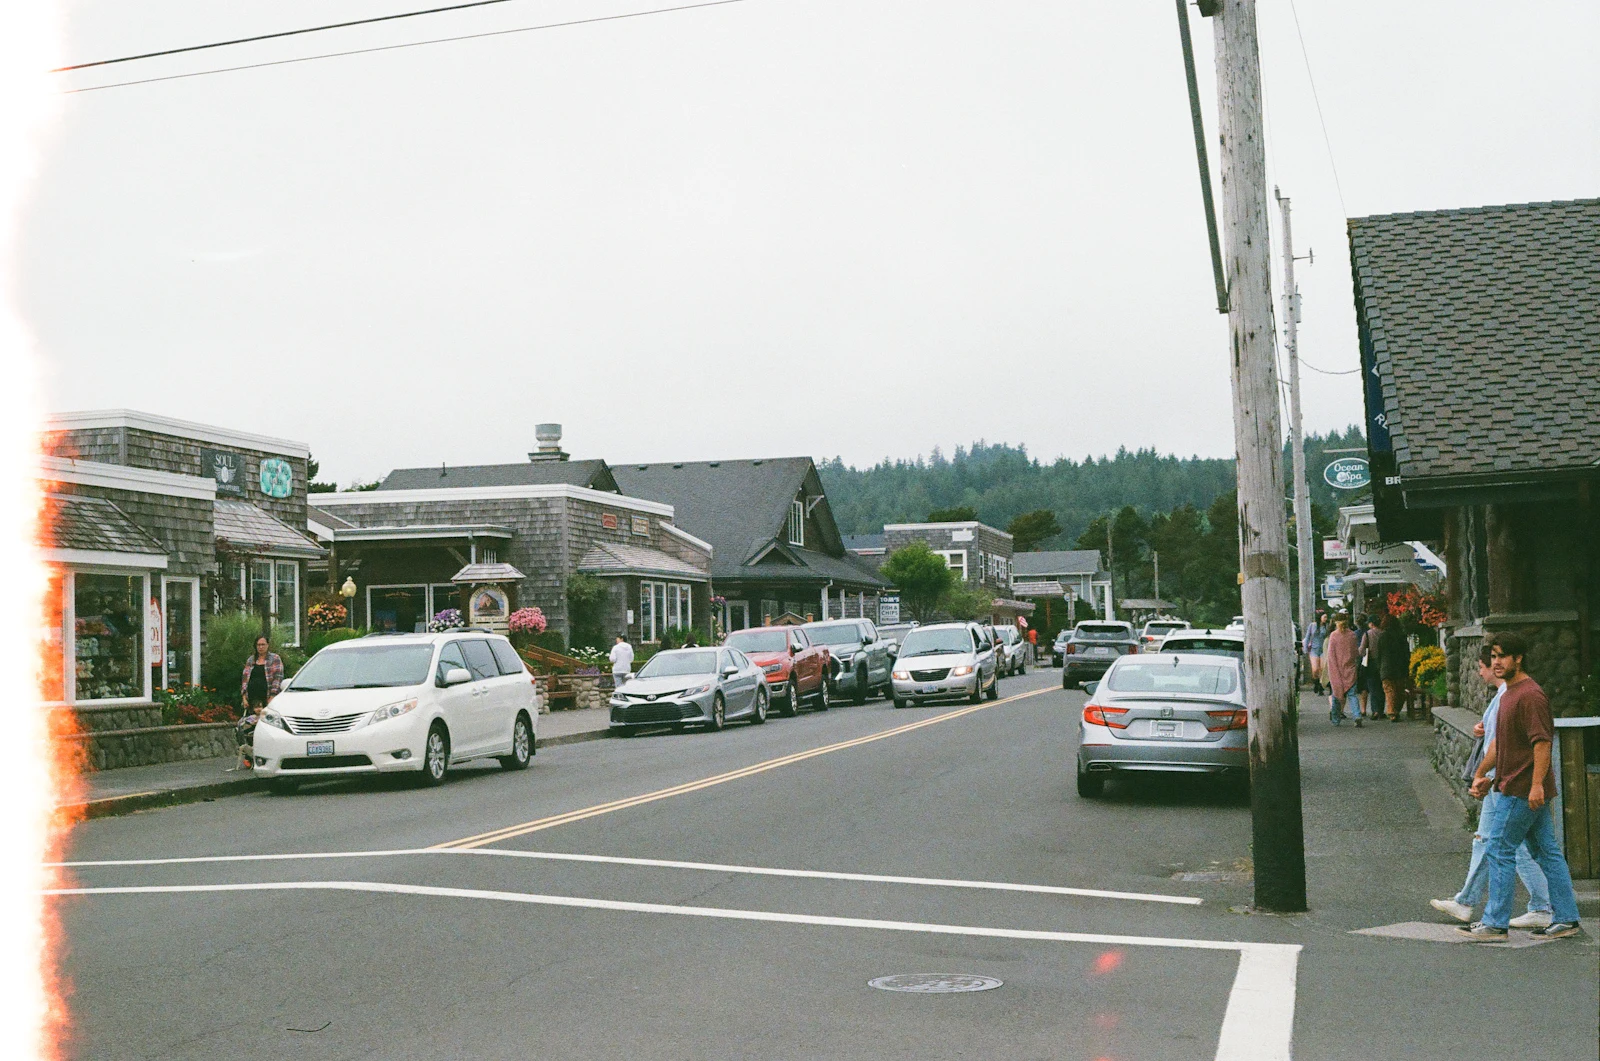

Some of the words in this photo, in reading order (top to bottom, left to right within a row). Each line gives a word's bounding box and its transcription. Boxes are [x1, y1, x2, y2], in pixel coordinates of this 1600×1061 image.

[215, 453, 235, 467] SOUL
[1334, 463, 1364, 472] Ocean
[1345, 471, 1363, 482] Spa
